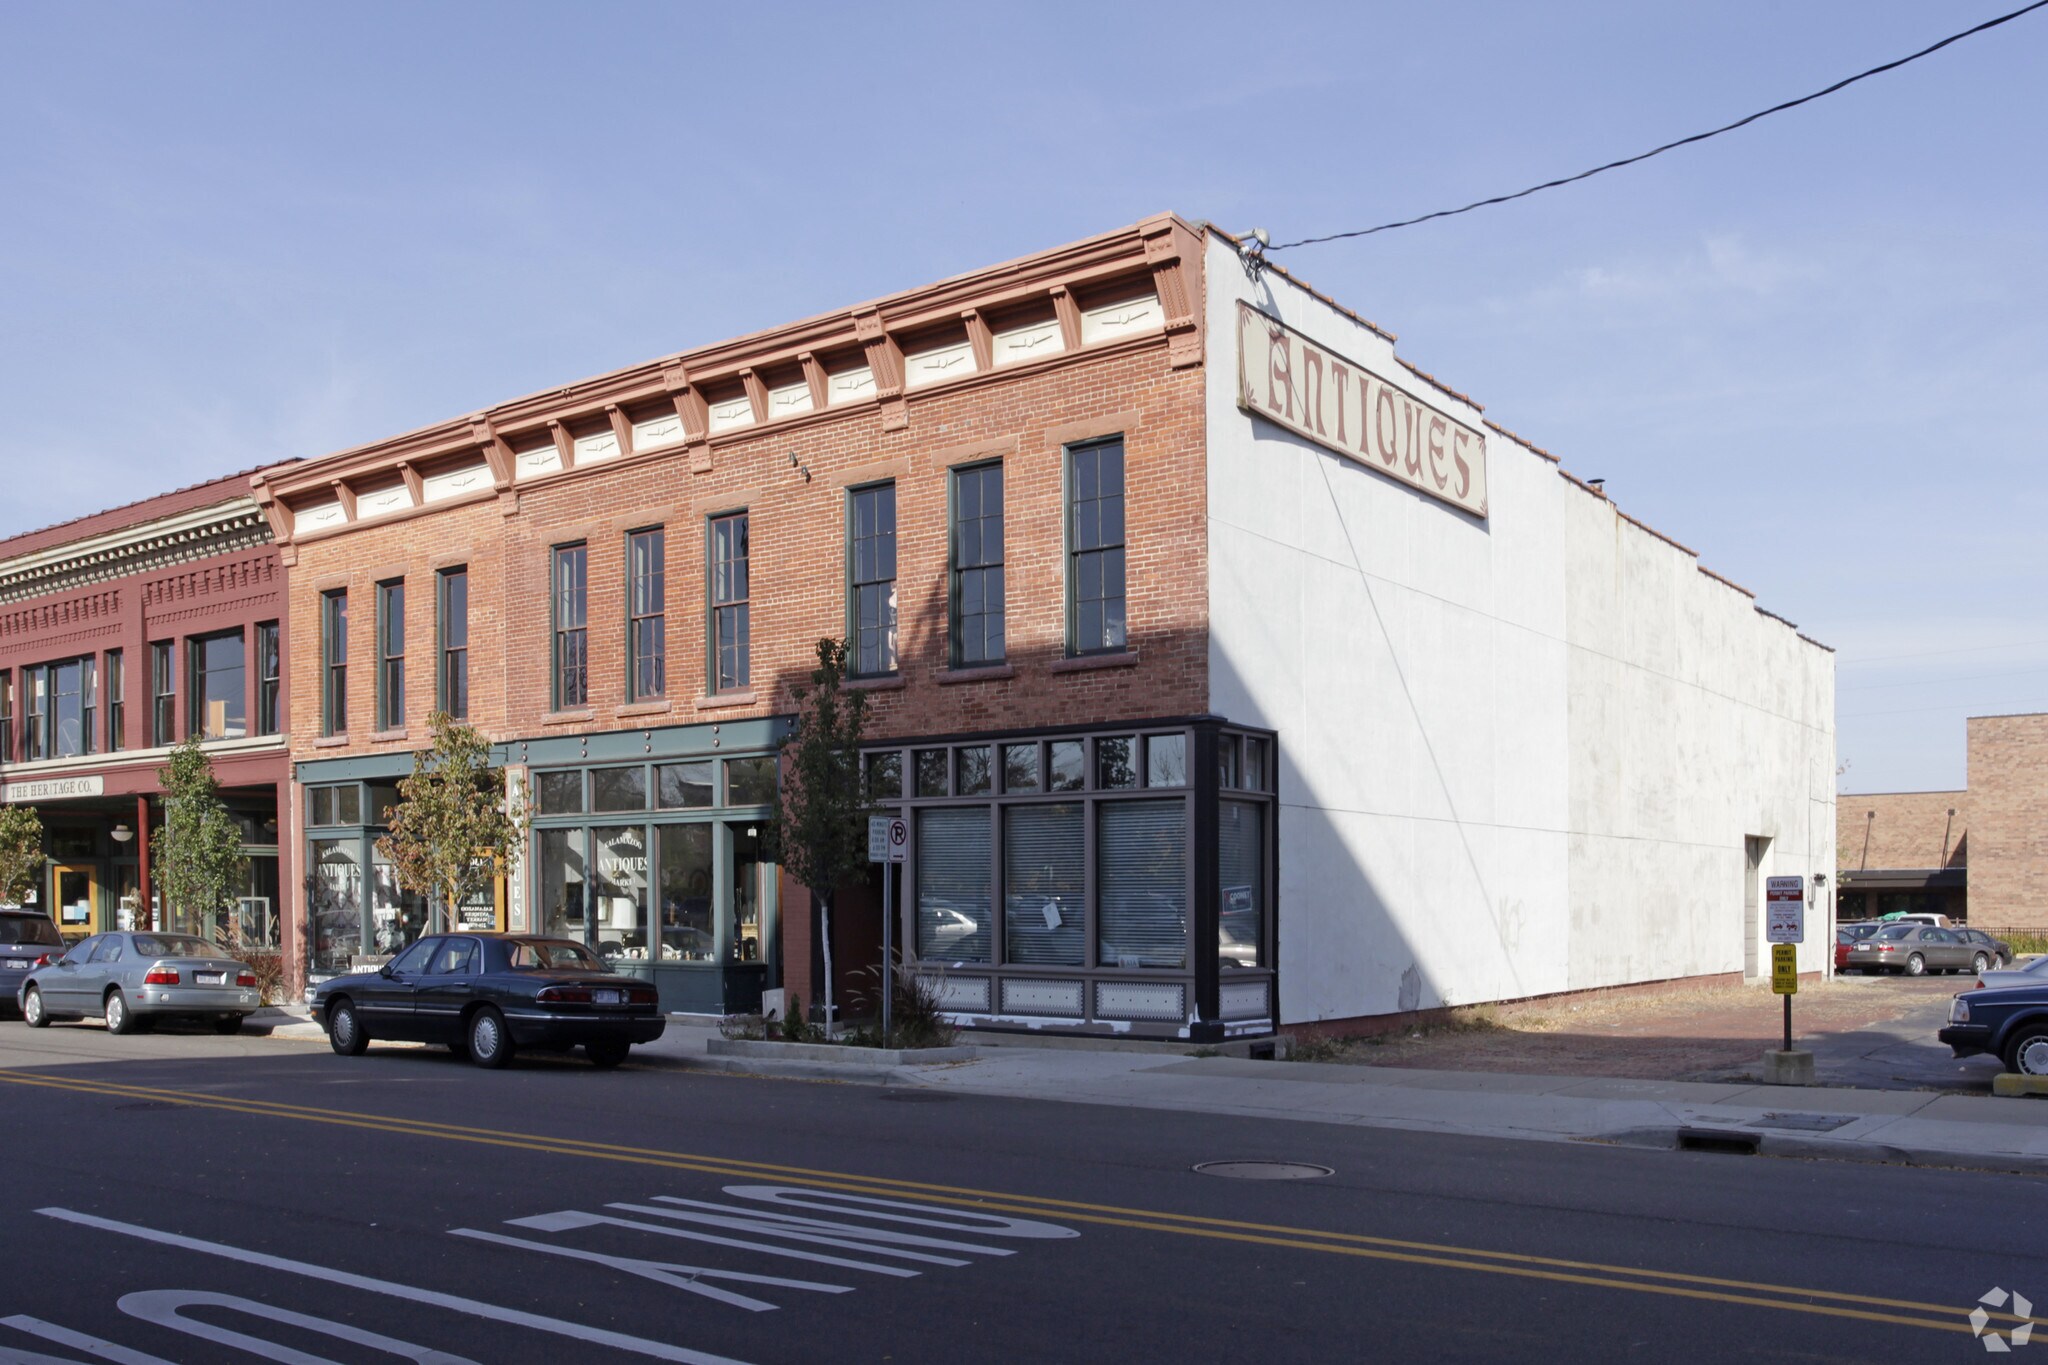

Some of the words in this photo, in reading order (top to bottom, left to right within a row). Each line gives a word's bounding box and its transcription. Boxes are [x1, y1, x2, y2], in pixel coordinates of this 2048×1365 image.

[1268, 328, 1470, 499] ANTIQUES
[11, 785, 28, 798] THE
[30, 781, 76, 797] HERITAGE
[77, 780, 92, 793] CO.
[511, 784, 522, 917] ATQUES
[604, 836, 643, 850] KALAMAZOO
[317, 863, 361, 877] ANTIQUES
[598, 857, 647, 874] ANTIQUES
[1771, 880, 1799, 888] WARNING
[351, 965, 386, 974] ANTIQU
[1778, 965, 1791, 973] ONLY
[445, 1184, 1082, 1313] ONLY
